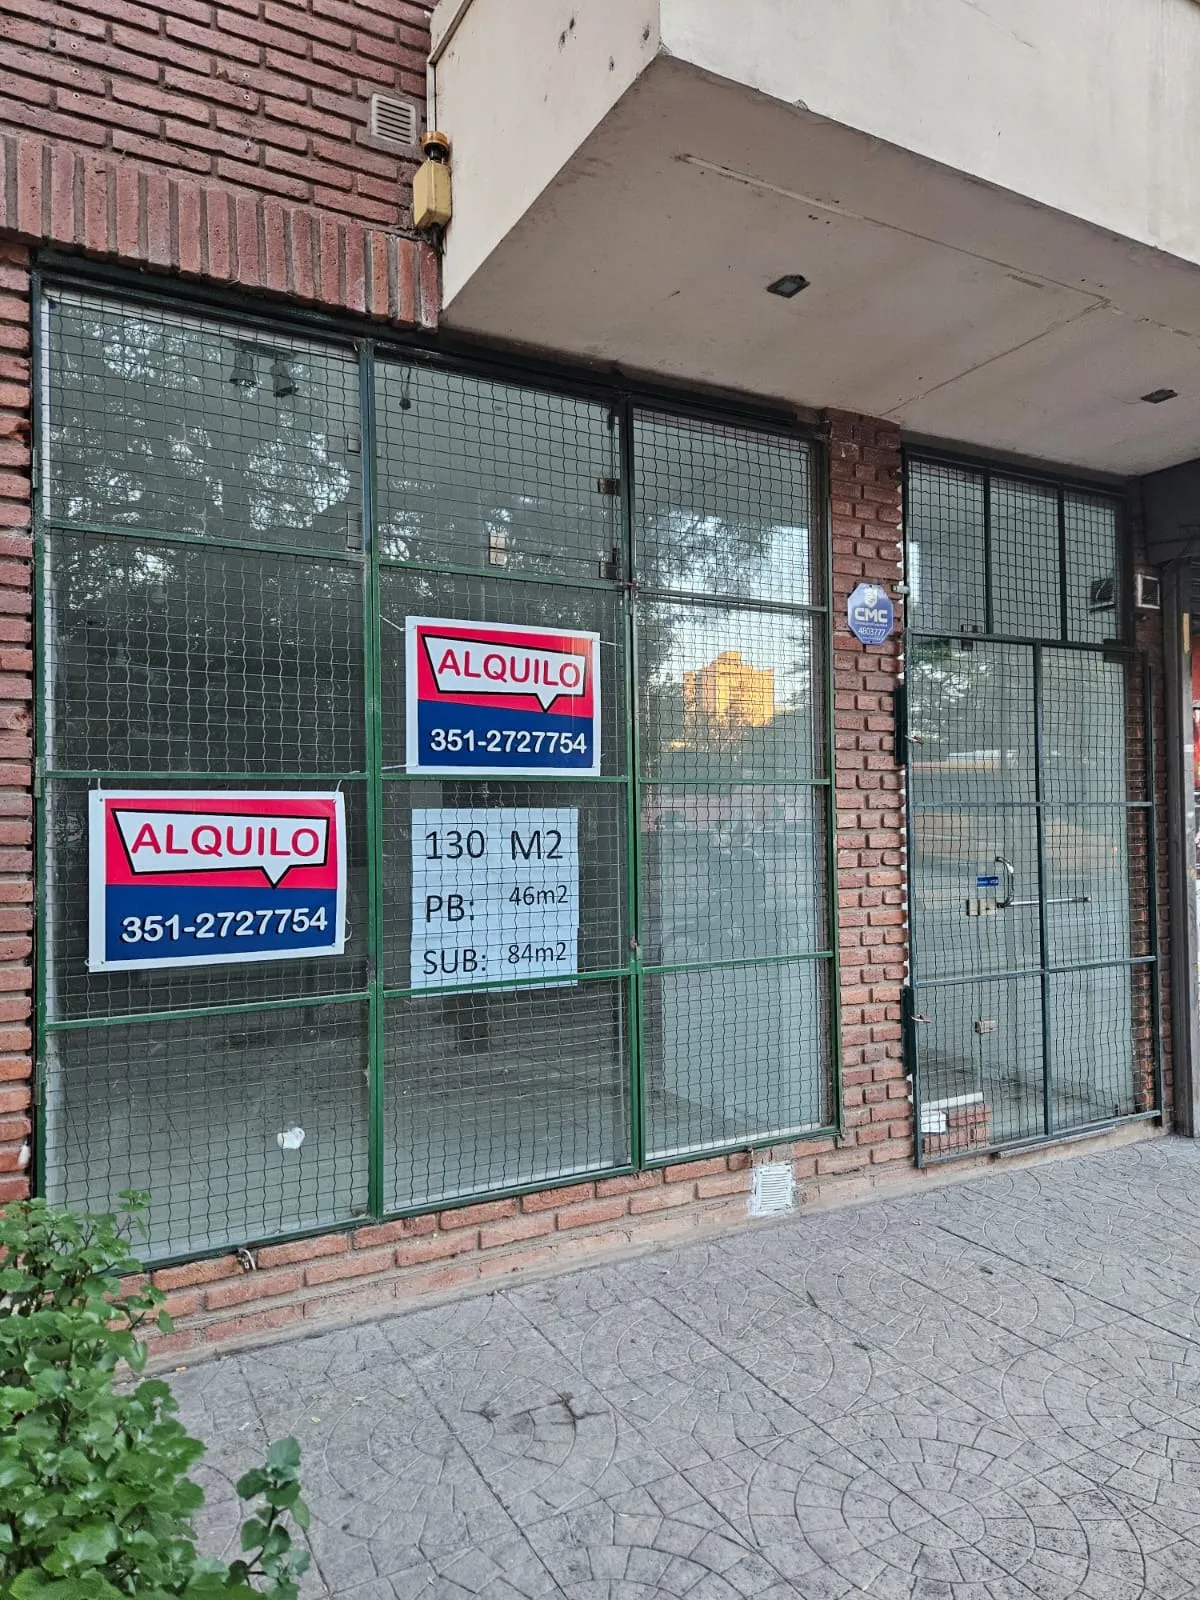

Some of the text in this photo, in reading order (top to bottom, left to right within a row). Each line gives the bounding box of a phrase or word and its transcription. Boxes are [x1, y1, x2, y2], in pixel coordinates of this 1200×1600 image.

[855, 608, 888, 623] CMC
[438, 649, 580, 688] ALQUILO
[430, 728, 587, 754] 351-2727754
[131, 823, 319, 857] ALQUILO
[425, 830, 563, 860] 130 M2
[425, 885, 569, 923] PB: 46m2
[120, 906, 328, 943] 351-2727754
[423, 942, 566, 975] SUB: 84m2
